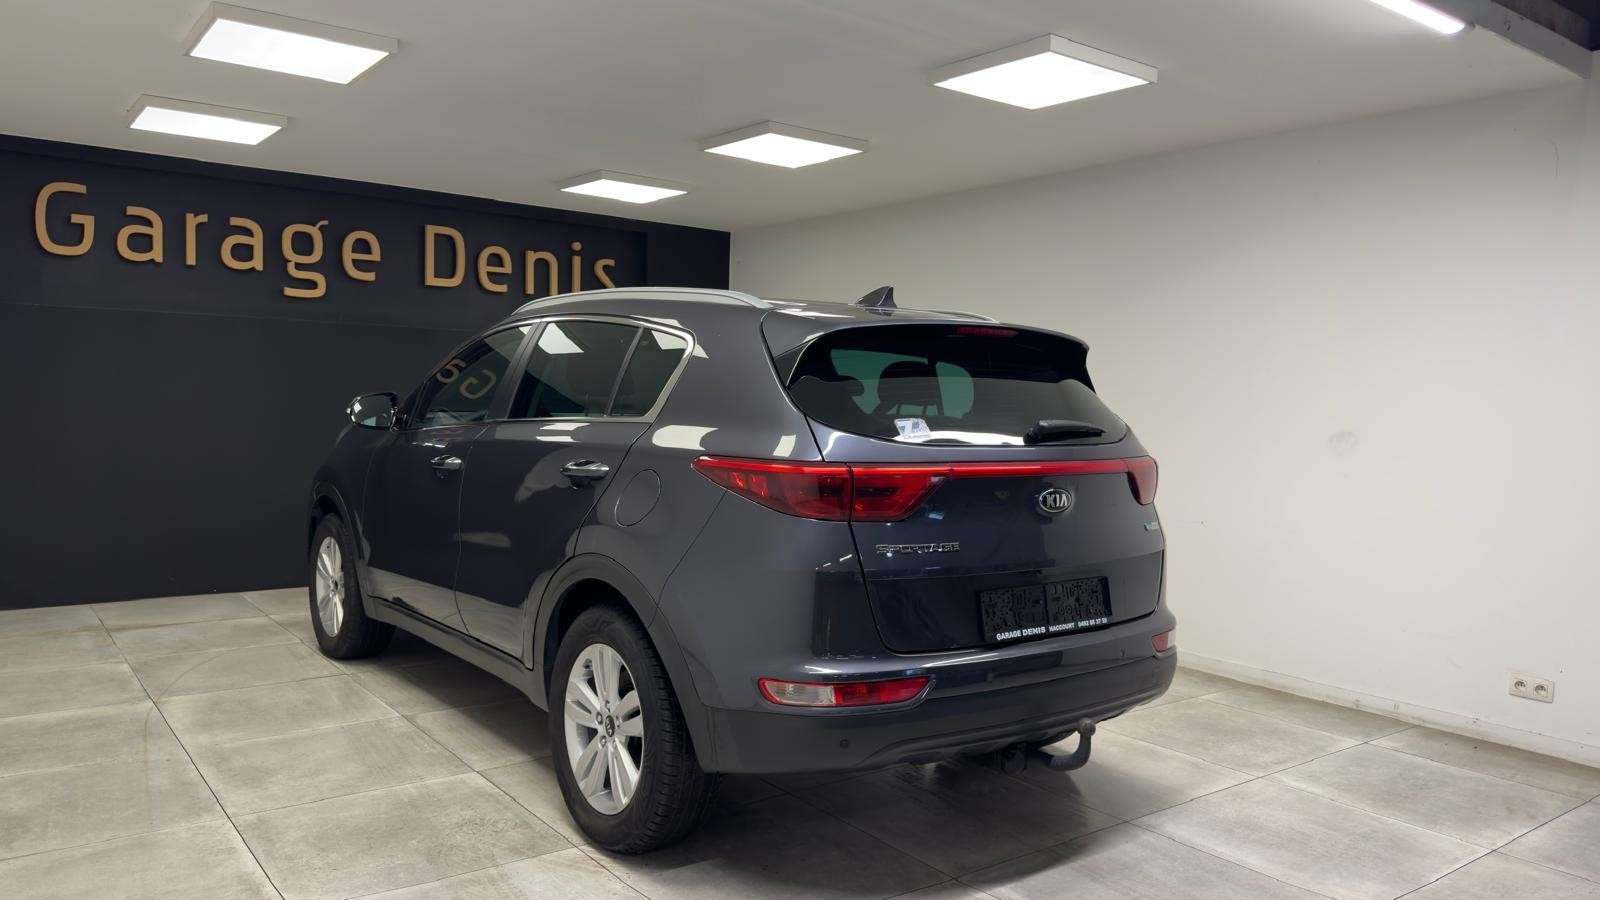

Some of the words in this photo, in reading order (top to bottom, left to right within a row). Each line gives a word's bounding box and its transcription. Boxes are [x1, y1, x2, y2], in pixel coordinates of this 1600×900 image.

[34, 181, 381, 298] Garage
[1046, 493, 1068, 508] KIA
[875, 542, 961, 554] SPORTAGE
[996, 629, 1022, 641] GARAGE
[1022, 626, 1046, 637] DENIS
